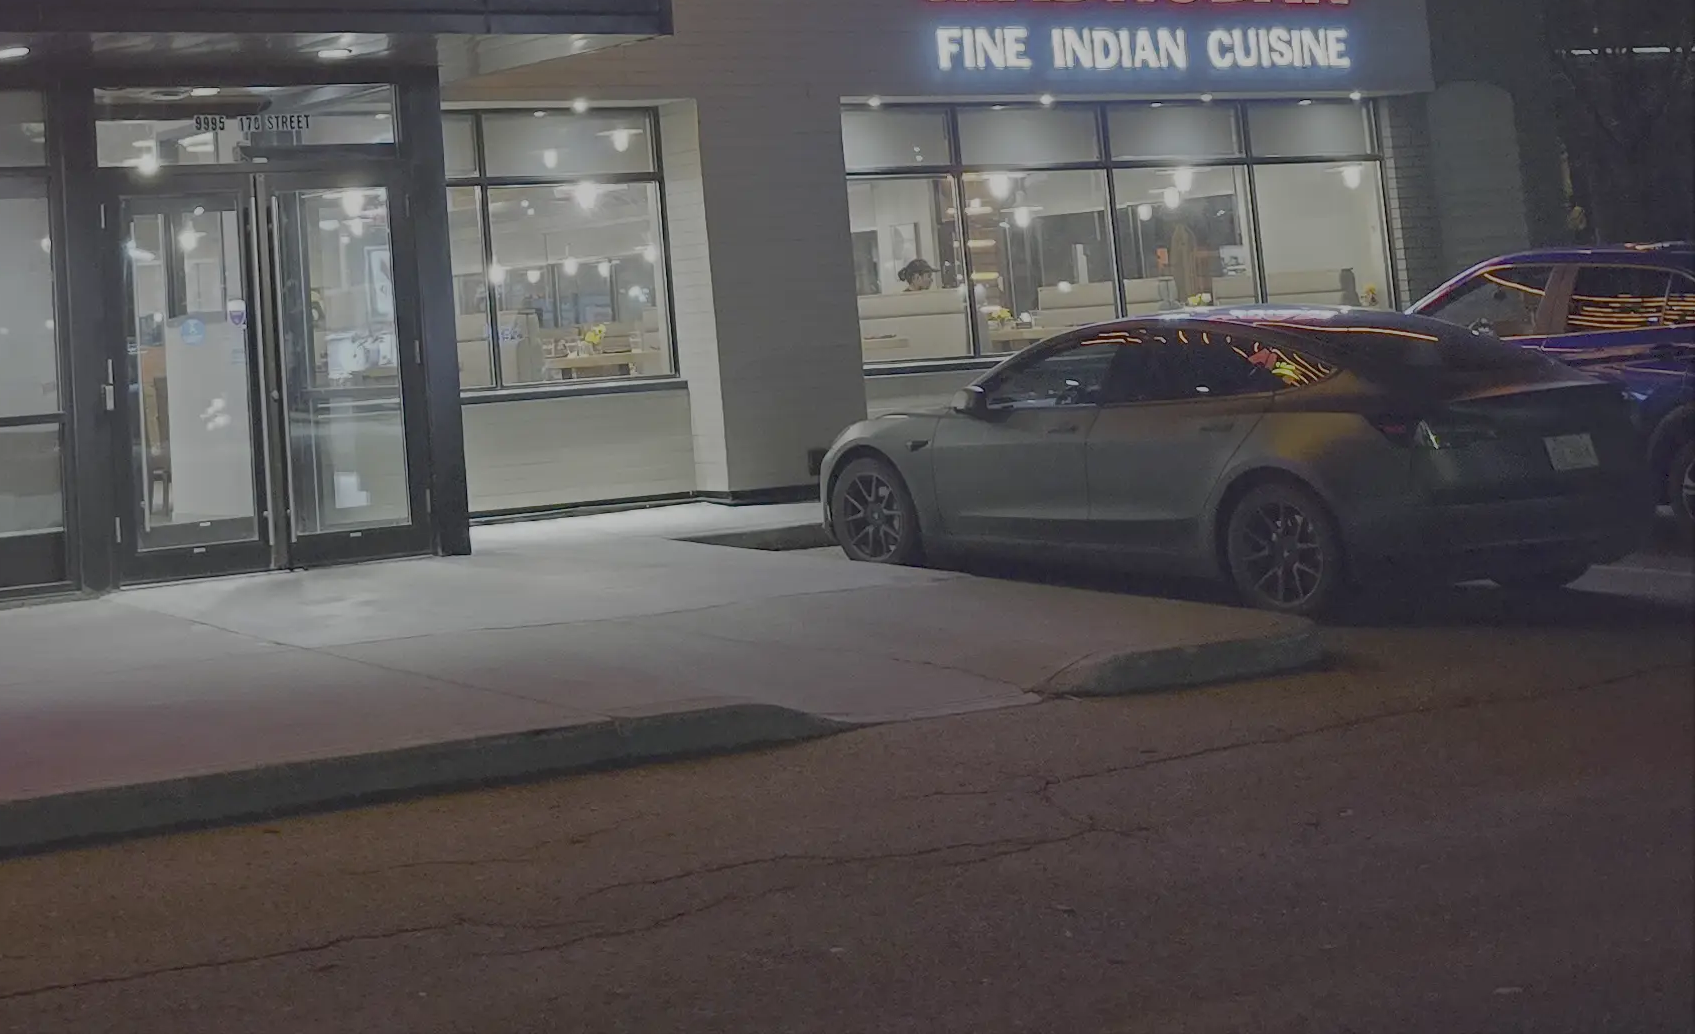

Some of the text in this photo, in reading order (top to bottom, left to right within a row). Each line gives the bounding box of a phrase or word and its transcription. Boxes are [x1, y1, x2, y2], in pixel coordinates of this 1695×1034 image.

[936, 27, 1351, 70] FINE INDIAN CUISINE
[195, 117, 225, 131] 9995
[267, 115, 310, 130] STREET
